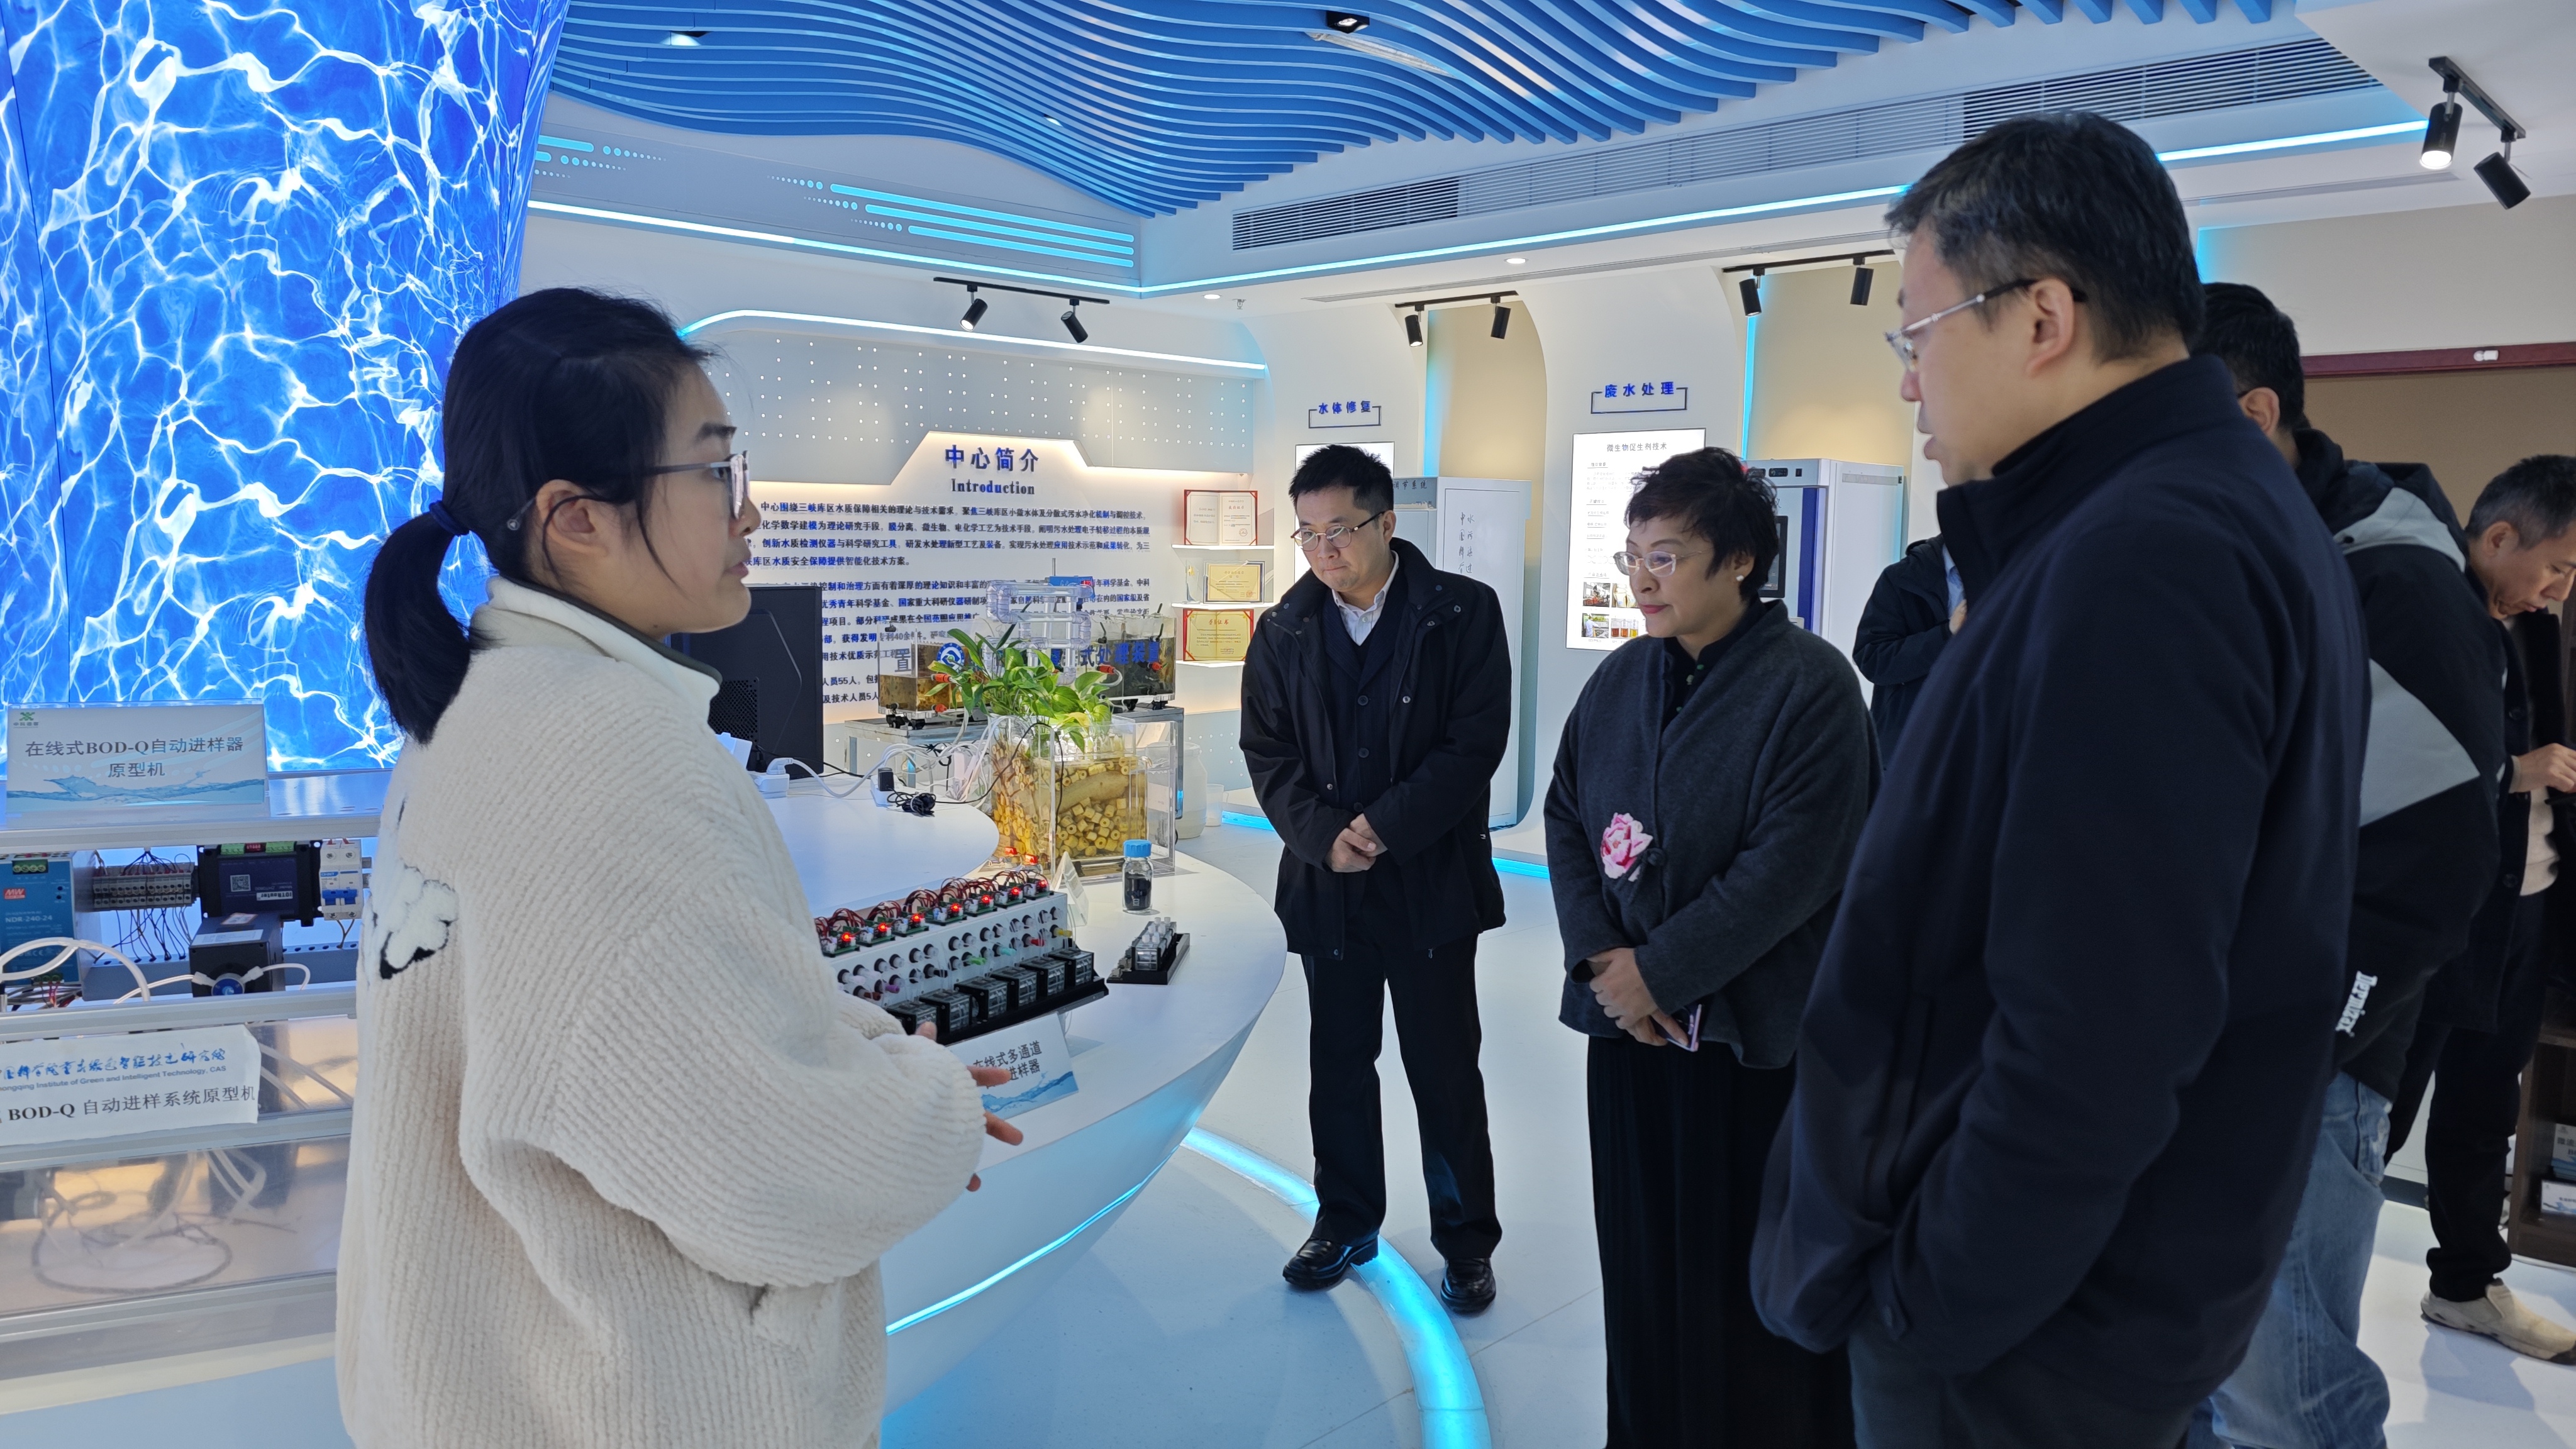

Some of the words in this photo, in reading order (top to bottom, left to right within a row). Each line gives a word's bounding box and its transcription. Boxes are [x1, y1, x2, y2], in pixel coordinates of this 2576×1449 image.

[1604, 381, 1674, 398] 废水处理
[1318, 400, 1371, 414] 水体修复
[1606, 441, 1667, 452] 微生物促生剂技术
[945, 444, 1039, 472] 中心简介
[950, 478, 1035, 495] Introduction
[25, 736, 244, 757] 在线式BOD-Q自动进样器
[108, 761, 166, 779] 原型机
[5, 914, 53, 923] NDR-240-24
[0, 1048, 226, 1080] 国科学院重庆绿色智能技术研究院
[36, 1080, 69, 1088] Institute
[122, 1071, 161, 1080] Intelligent
[8, 1103, 75, 1121] BOD-Q
[84, 1085, 255, 1116] 自动进样系统原型机
